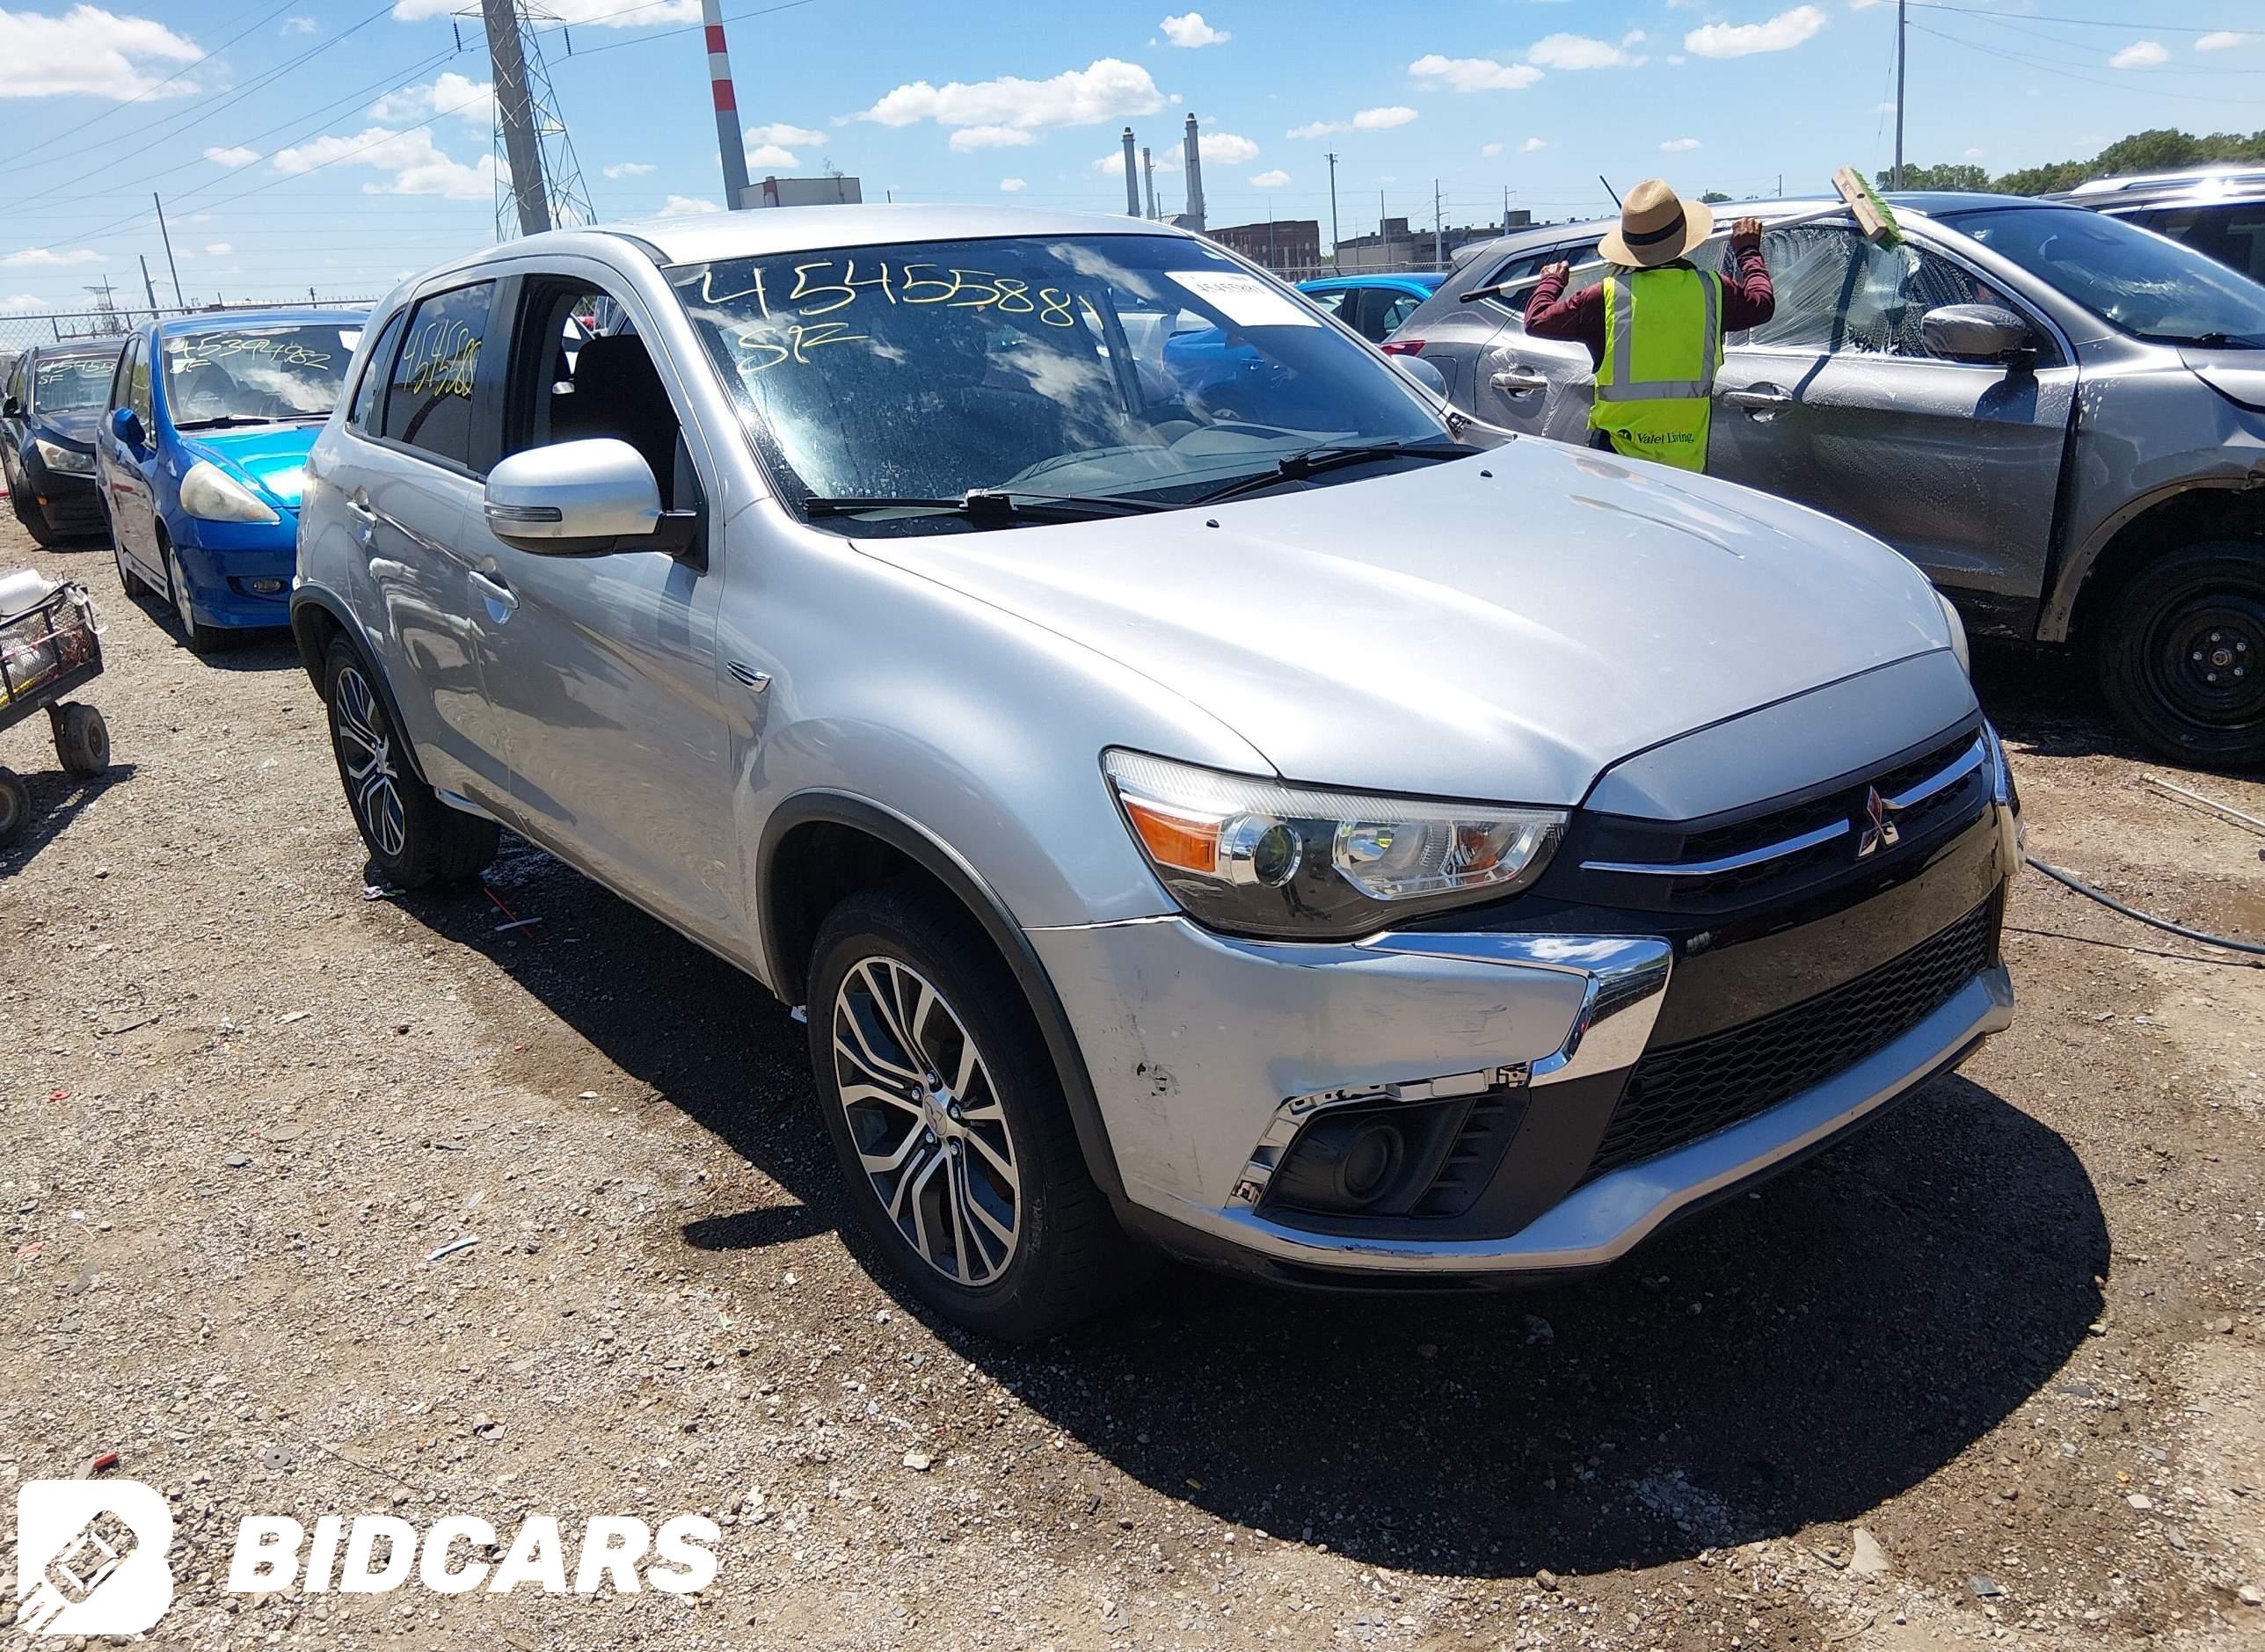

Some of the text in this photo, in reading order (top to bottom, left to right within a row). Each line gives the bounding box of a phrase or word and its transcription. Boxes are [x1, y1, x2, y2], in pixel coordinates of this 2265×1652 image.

[703, 260, 1104, 331] 45455881
[38, 375, 64, 385] SF
[1637, 432, 1694, 444] Valet Living
